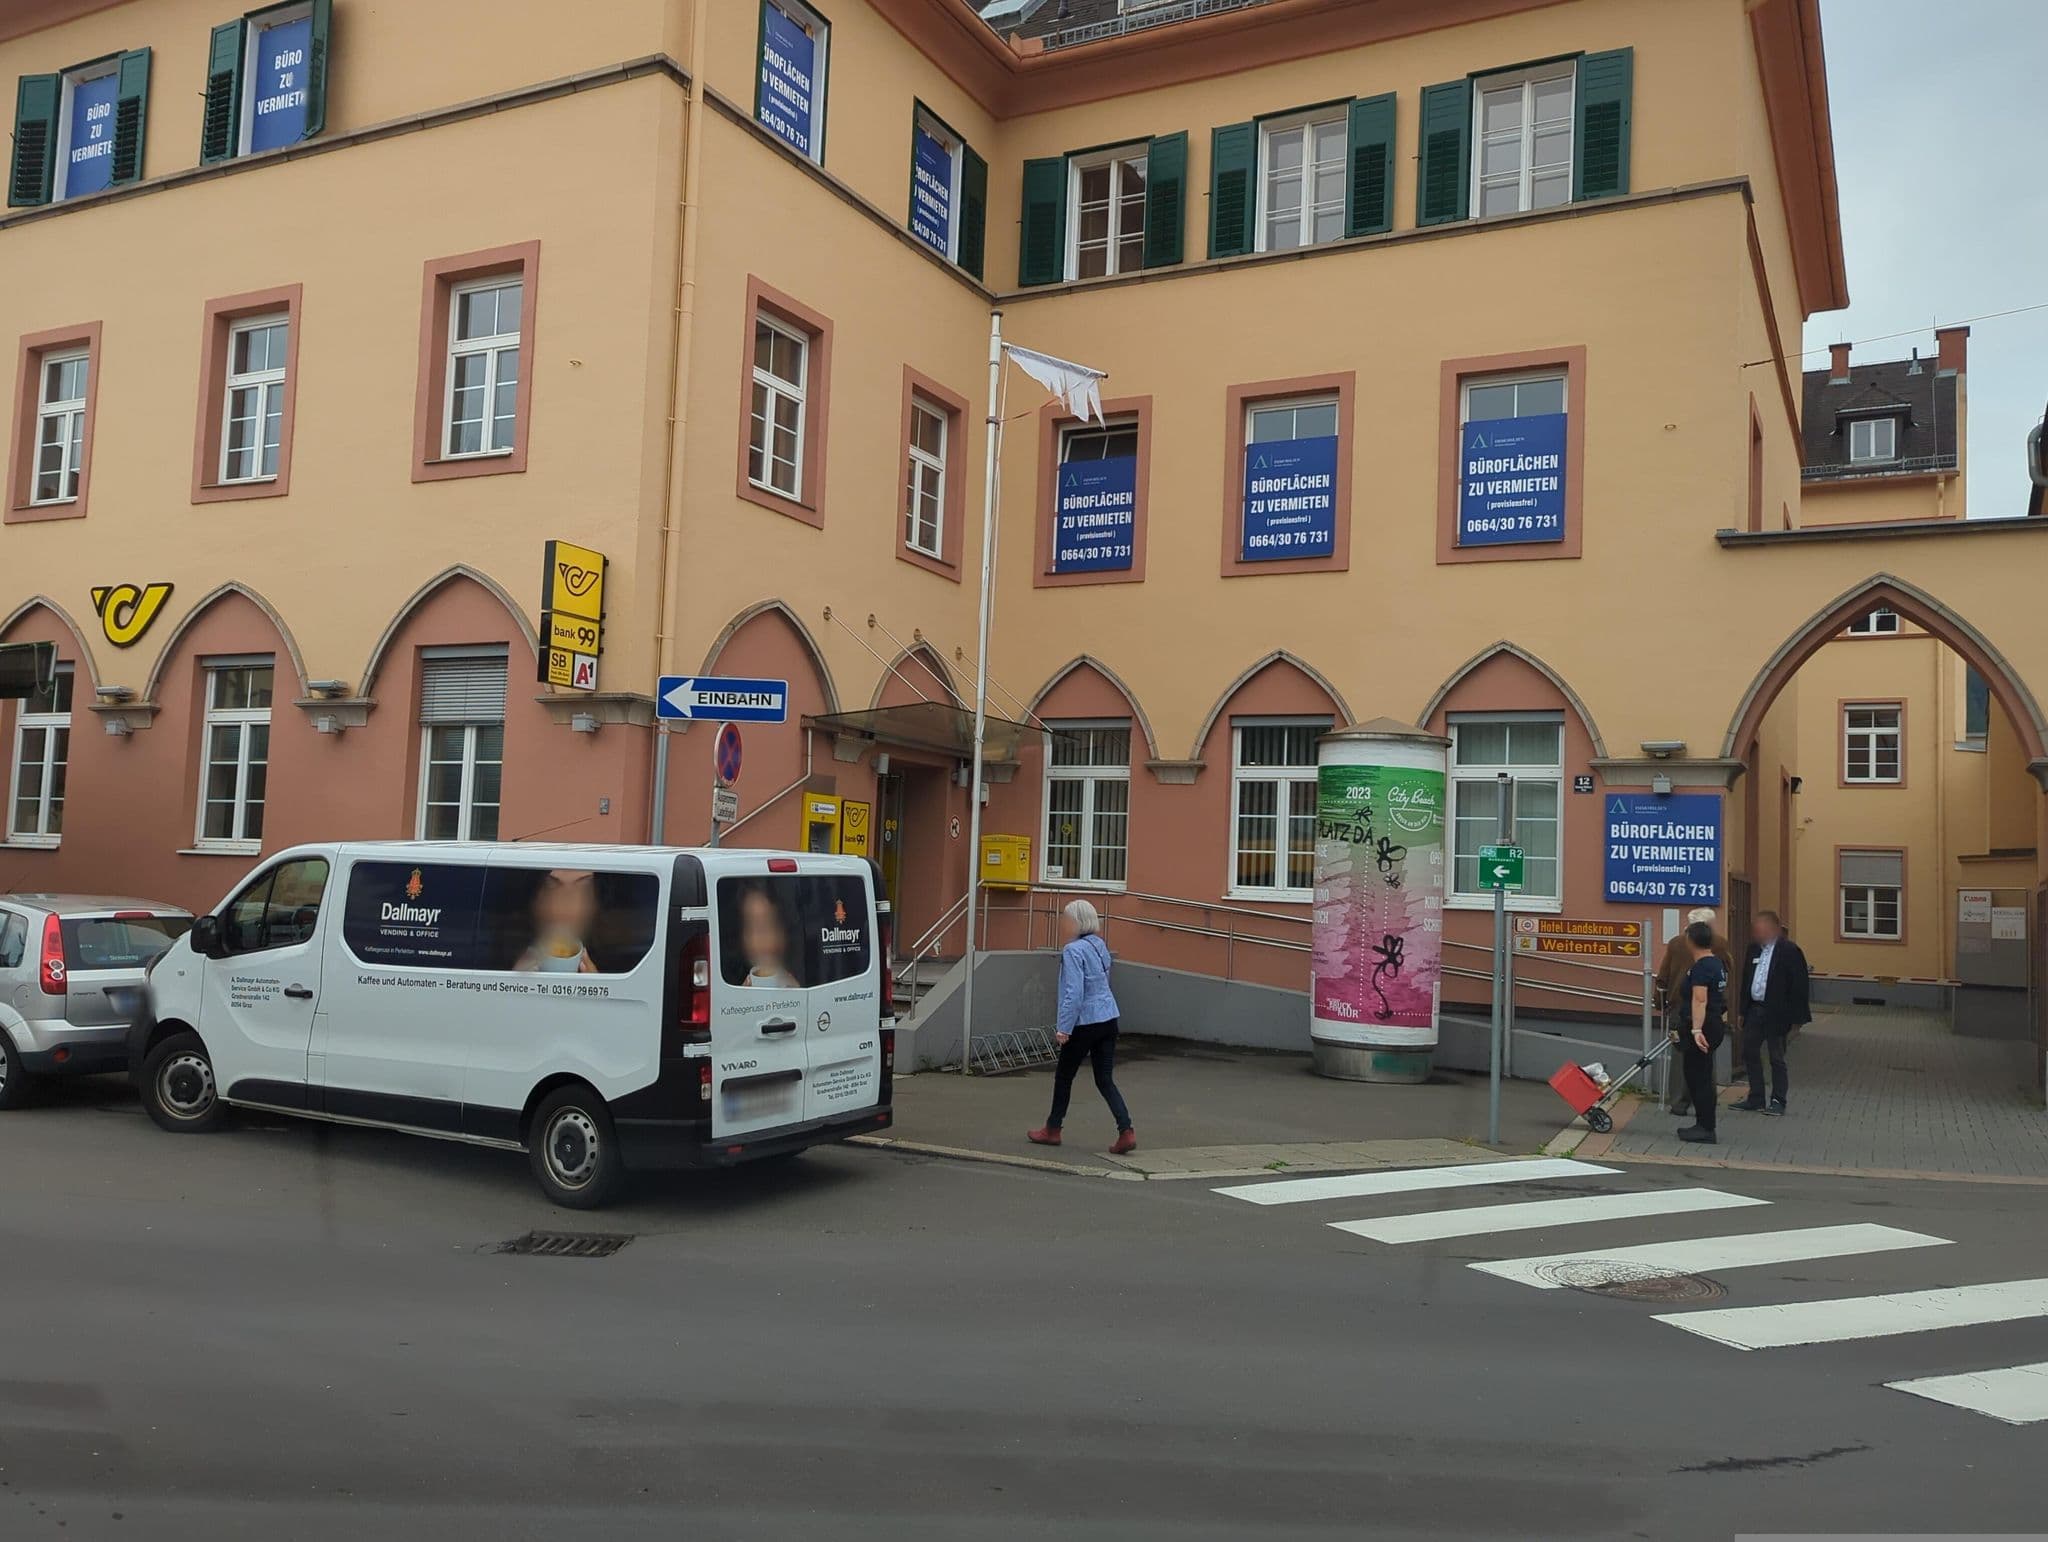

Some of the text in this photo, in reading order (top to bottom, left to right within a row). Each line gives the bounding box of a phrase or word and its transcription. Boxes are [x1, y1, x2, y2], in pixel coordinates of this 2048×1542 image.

[274, 48, 303, 70] BÜRO
[279, 72, 294, 89] ZU
[769, 75, 809, 115] VERMIETEN
[87, 102, 111, 121] BÜRO
[90, 123, 103, 139] ZU
[786, 123, 795, 142] 76
[795, 130, 808, 151] 731
[1469, 453, 1559, 475] BÜROFLÄCHEN
[1251, 473, 1330, 494] BÜROFLÄCHEN
[1468, 476, 1558, 497] ZU VERMIETEN
[1063, 491, 1133, 510] BÜROFLÄCHEN
[1250, 495, 1330, 514] ZU VERMIETEN
[1062, 511, 1132, 529] ZU VERMIETEN
[1467, 514, 1558, 533] 0664/30 76 731
[1249, 530, 1329, 548] 0664/30 76 731
[1061, 545, 1131, 562] 0664/30 76 731
[554, 624, 596, 648] bank 99
[551, 652, 567, 668] SB
[575, 661, 594, 685] A1
[697, 692, 772, 706] EINBAHN
[1578, 777, 1591, 785] 12
[1346, 786, 1371, 800] 2023
[1388, 786, 1436, 810] City Beach
[1610, 821, 1715, 841] BÜROFLÄCHEN
[1509, 849, 1523, 859] R2
[1610, 845, 1715, 862] ZU VERMIETEN
[1610, 881, 1715, 897] 0664/30 76 731
[381, 902, 441, 926] Dallmayr
[380, 929, 408, 937] VENDING
[416, 930, 439, 938] OFFICE
[821, 927, 860, 943] Dallmayr
[1540, 920, 1614, 935] Hotel Landskron
[1542, 938, 1612, 955] Weitental
[357, 975, 381, 985] Kaffee
[381, 977, 396, 986] und
[396, 977, 437, 988] Automaten
[446, 979, 481, 992] Beratung
[482, 982, 498, 991] und
[499, 982, 529, 993] Service
[720, 999, 801, 1016] Kaffeegenuss in Perfektion
[721, 1059, 758, 1072] VIVARO
